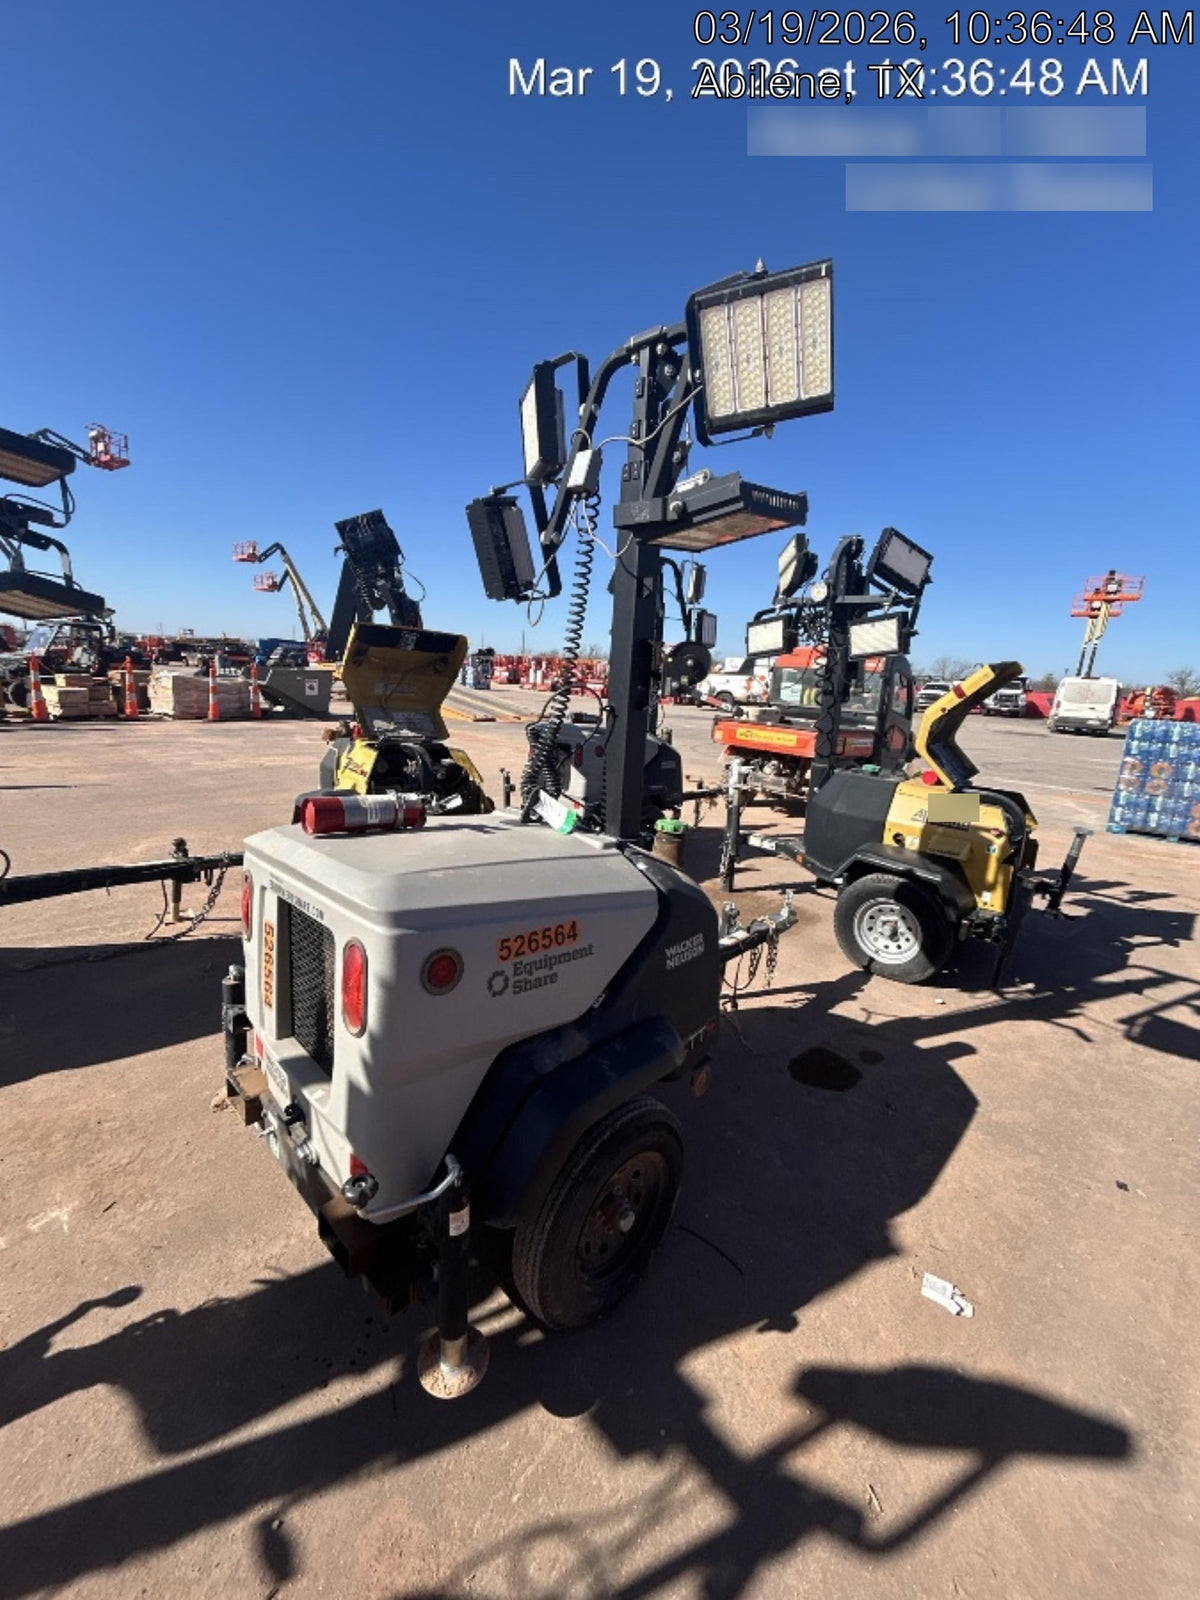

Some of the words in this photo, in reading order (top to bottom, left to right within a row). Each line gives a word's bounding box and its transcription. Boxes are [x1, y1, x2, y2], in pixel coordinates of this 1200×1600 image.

[498, 920, 578, 961] 526564
[666, 943, 705, 970] NEUSON
[264, 921, 275, 1009] 526564
[512, 943, 595, 977] Equipment
[512, 972, 559, 995] Share
